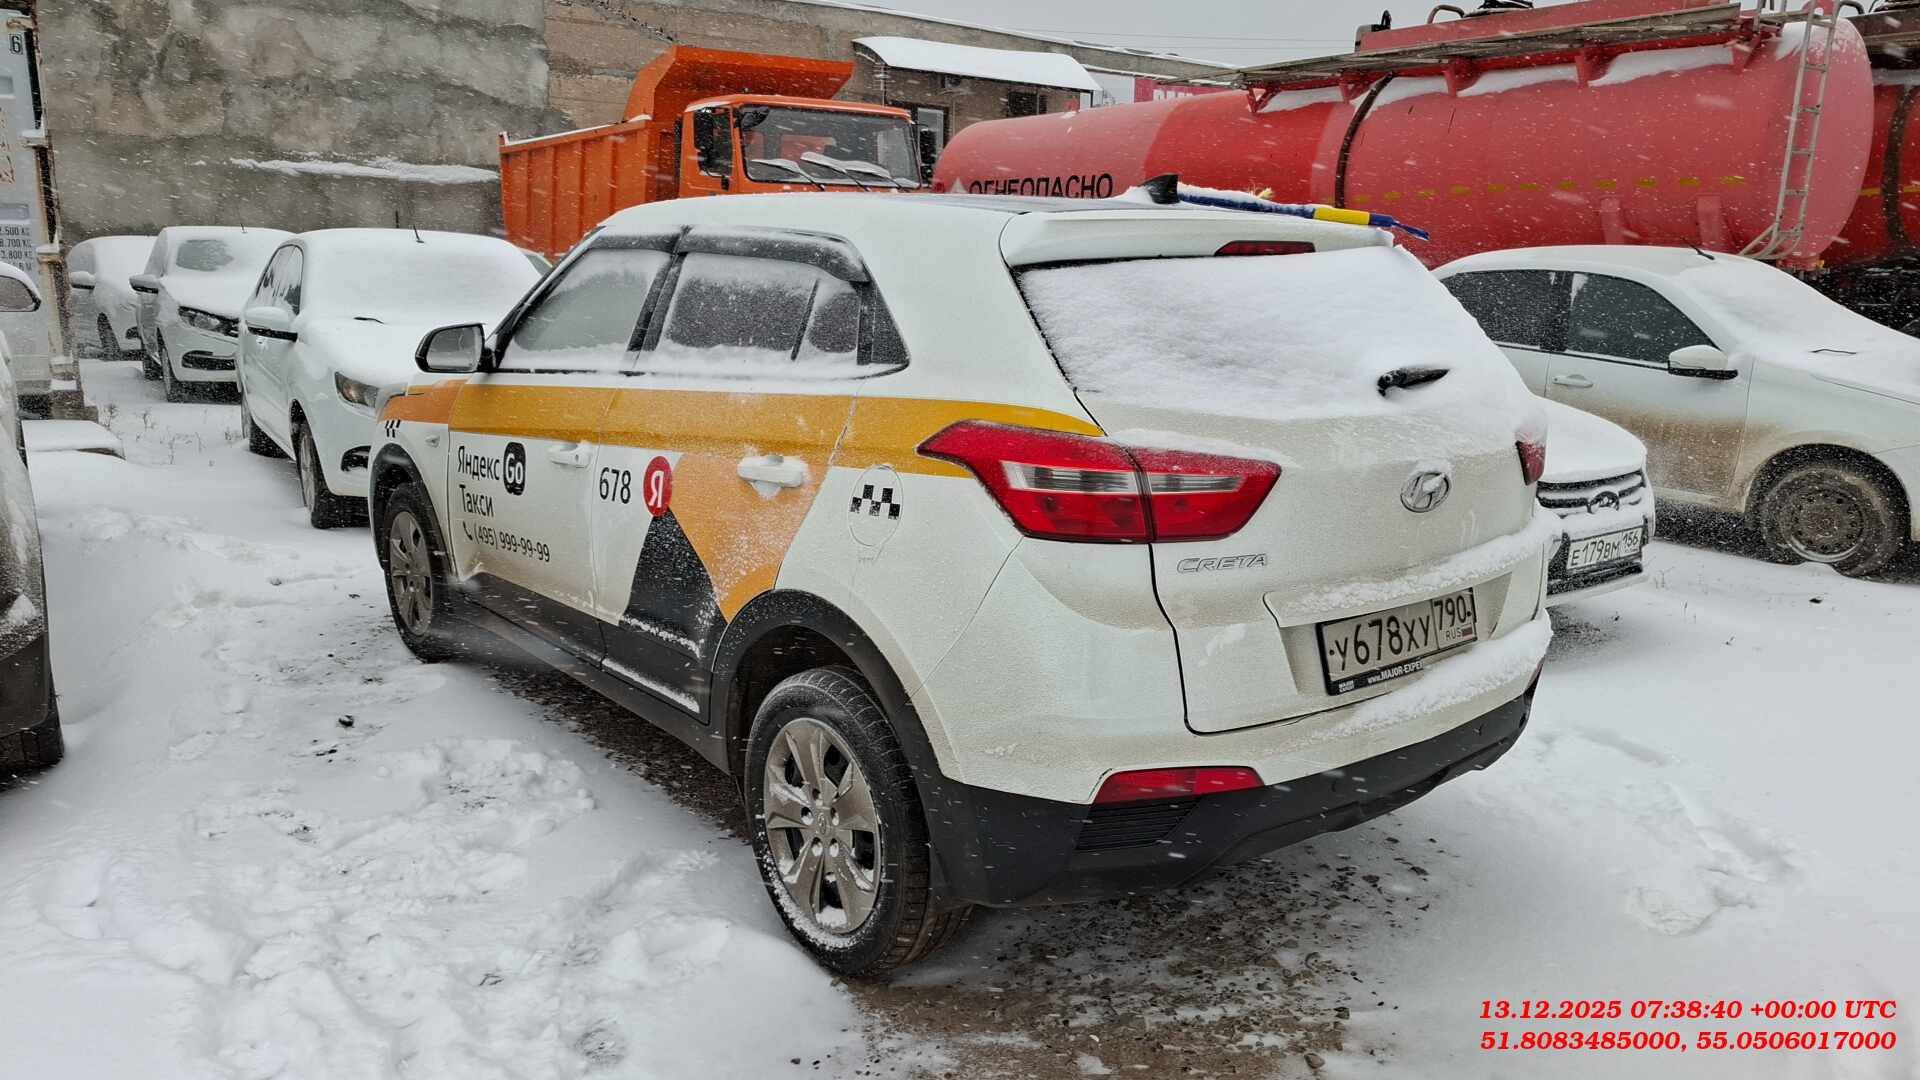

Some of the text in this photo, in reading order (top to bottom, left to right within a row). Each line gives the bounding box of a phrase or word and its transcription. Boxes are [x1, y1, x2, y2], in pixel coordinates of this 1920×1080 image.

[11, 34, 21, 54] 6
[969, 173, 1113, 199] ОГНЕОПАСНО
[457, 445, 525, 485] Яндекс Go
[459, 484, 495, 518] Такси
[599, 467, 632, 505] 678
[649, 470, 665, 508] Я
[474, 523, 551, 562] (495) 999-99-99
[1176, 554, 1267, 574] CRETA
[1334, 594, 1467, 671] У678ХУ 790
[1445, 627, 1463, 641] RUS
